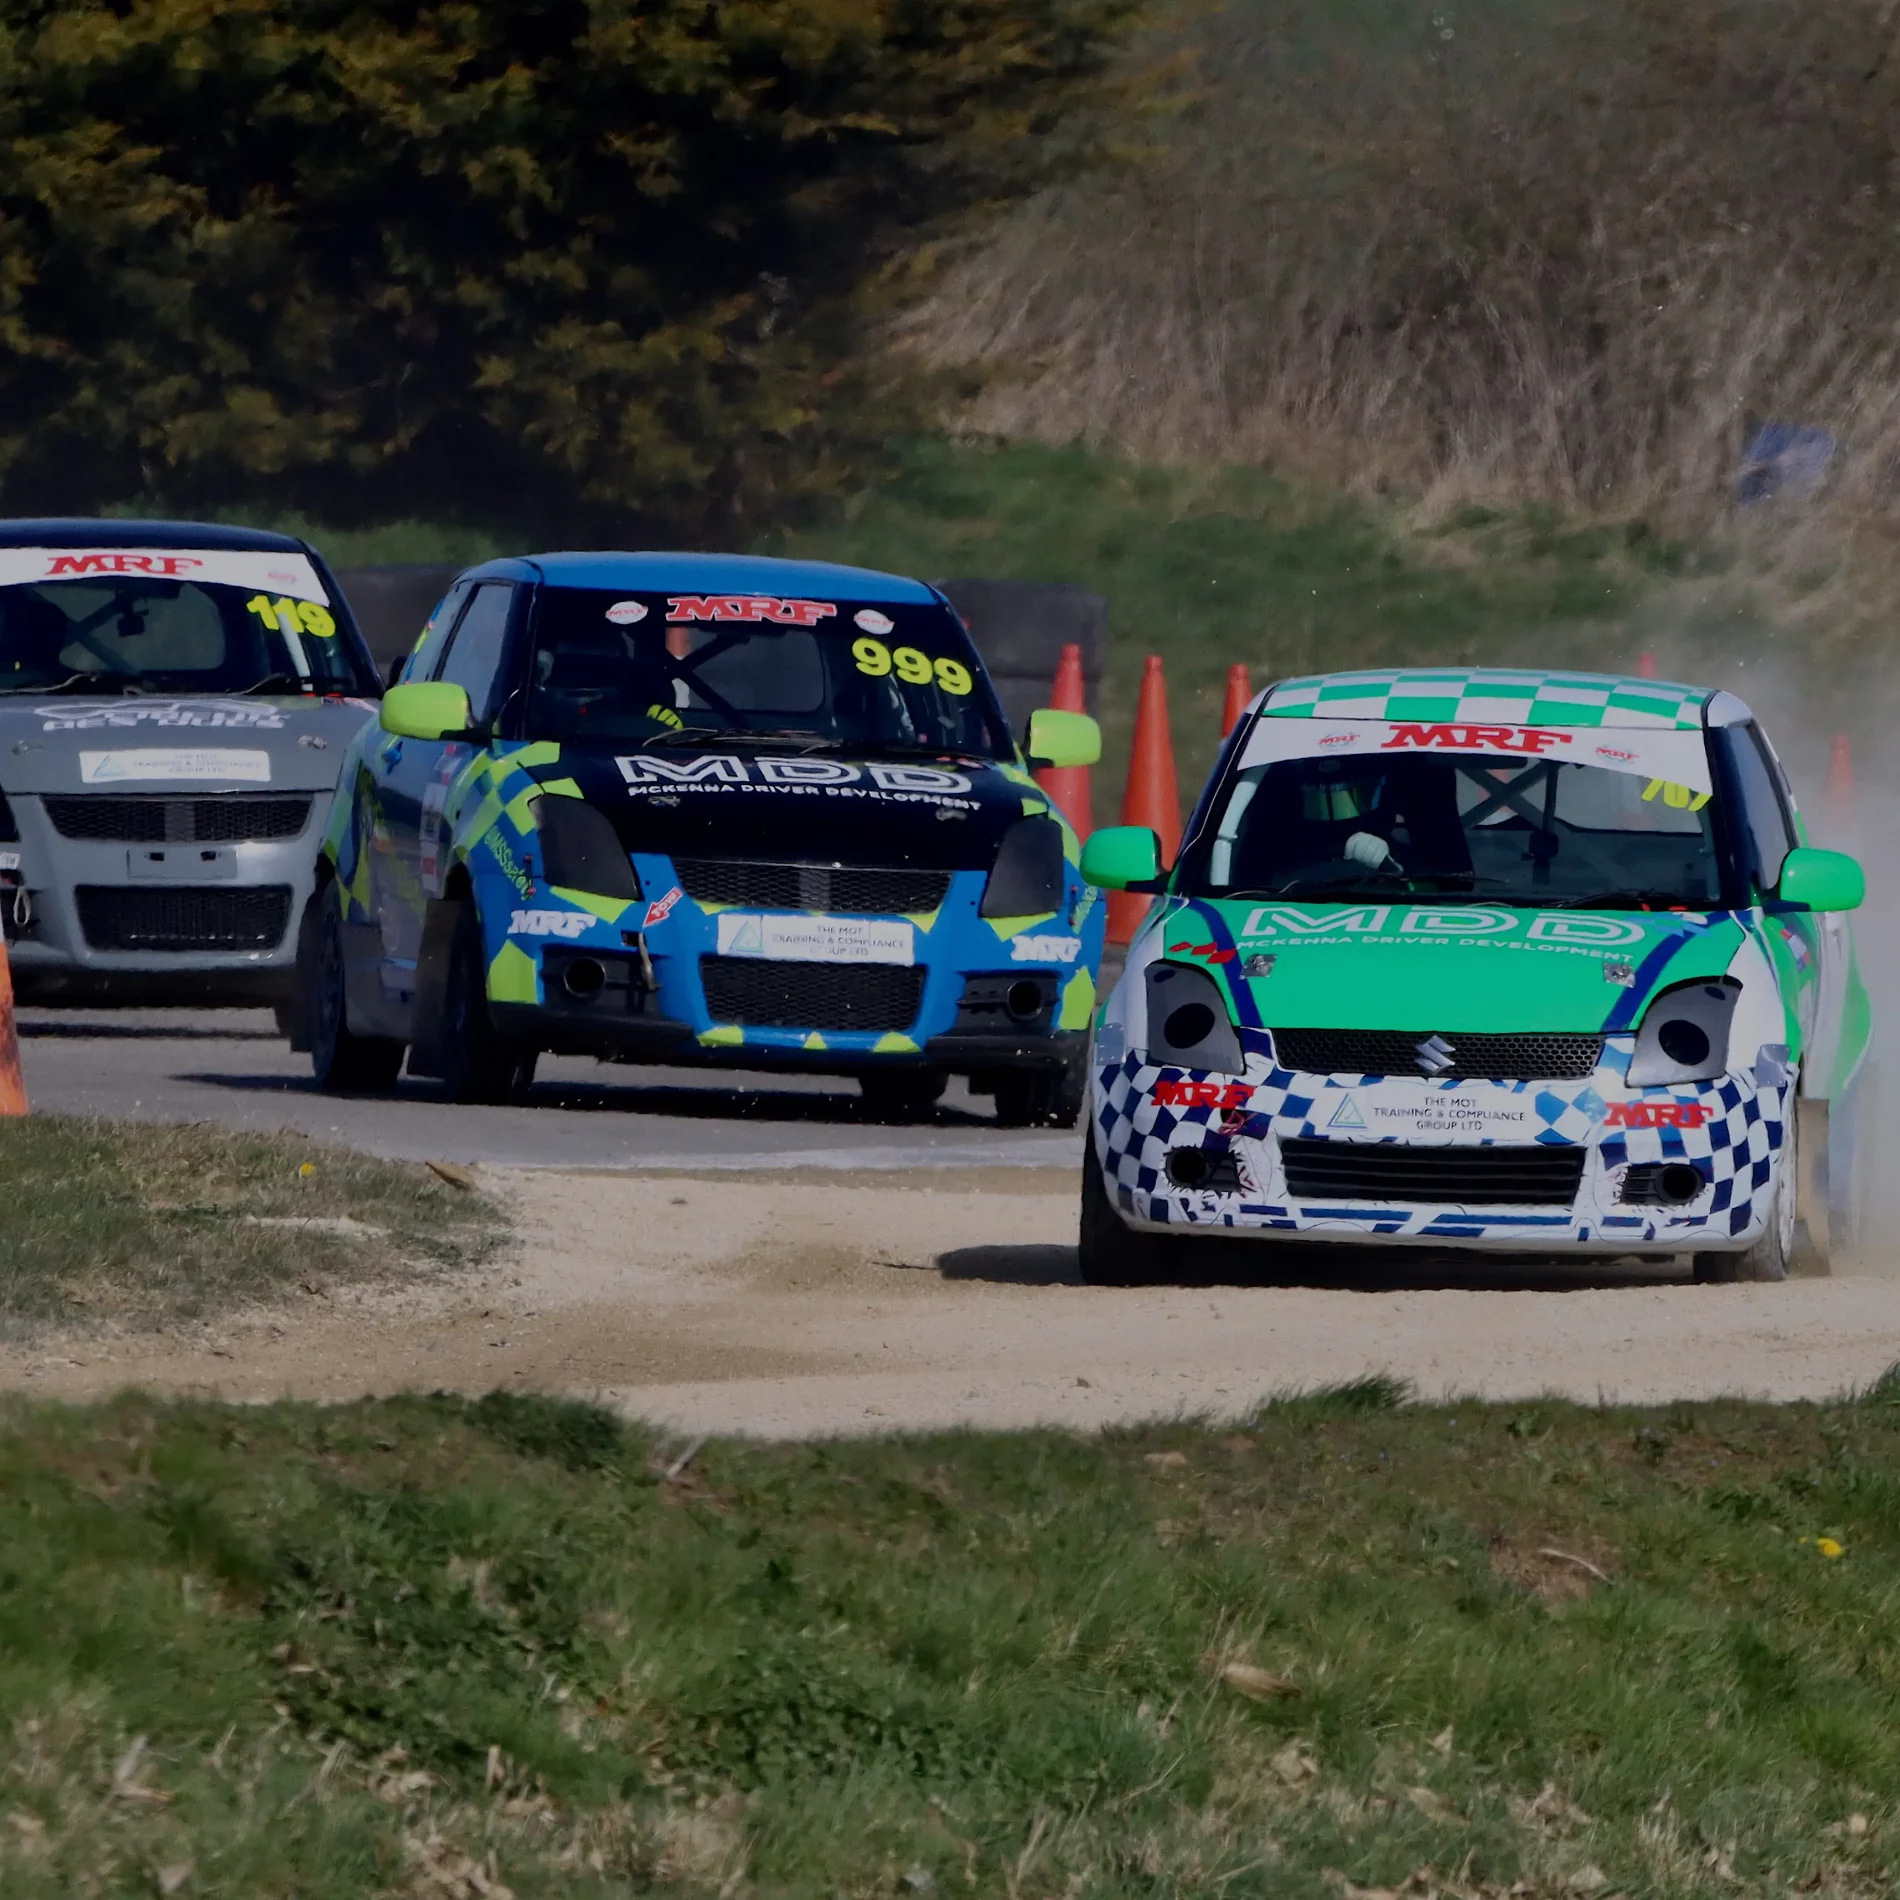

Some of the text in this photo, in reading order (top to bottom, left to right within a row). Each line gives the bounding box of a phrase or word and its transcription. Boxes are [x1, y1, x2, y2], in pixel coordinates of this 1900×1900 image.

[45, 554, 203, 577] MRF
[247, 595, 335, 638] 119
[666, 596, 837, 626] MRF
[852, 637, 972, 696] 999
[1381, 724, 1572, 754] MRF
[614, 755, 973, 795] MDD
[628, 783, 982, 811] MCKENNA DRIVER DEVELOPMENT
[651, 892, 679, 916] TOW
[507, 909, 597, 938] MRF
[816, 925, 836, 935] THE
[1241, 905, 1646, 946] MDD
[1236, 935, 1635, 963] MCKENNA DRIVER DEVELOPMENT
[1151, 1081, 1255, 1109] MRF
[1424, 1096, 1477, 1108] THE MOT
[1373, 1107, 1432, 1118] TRAINING
[1449, 1109, 1526, 1121] COMPLIANCE
[1416, 1120, 1482, 1131] GROUP LTD
[1603, 1102, 1713, 1129] MRF
